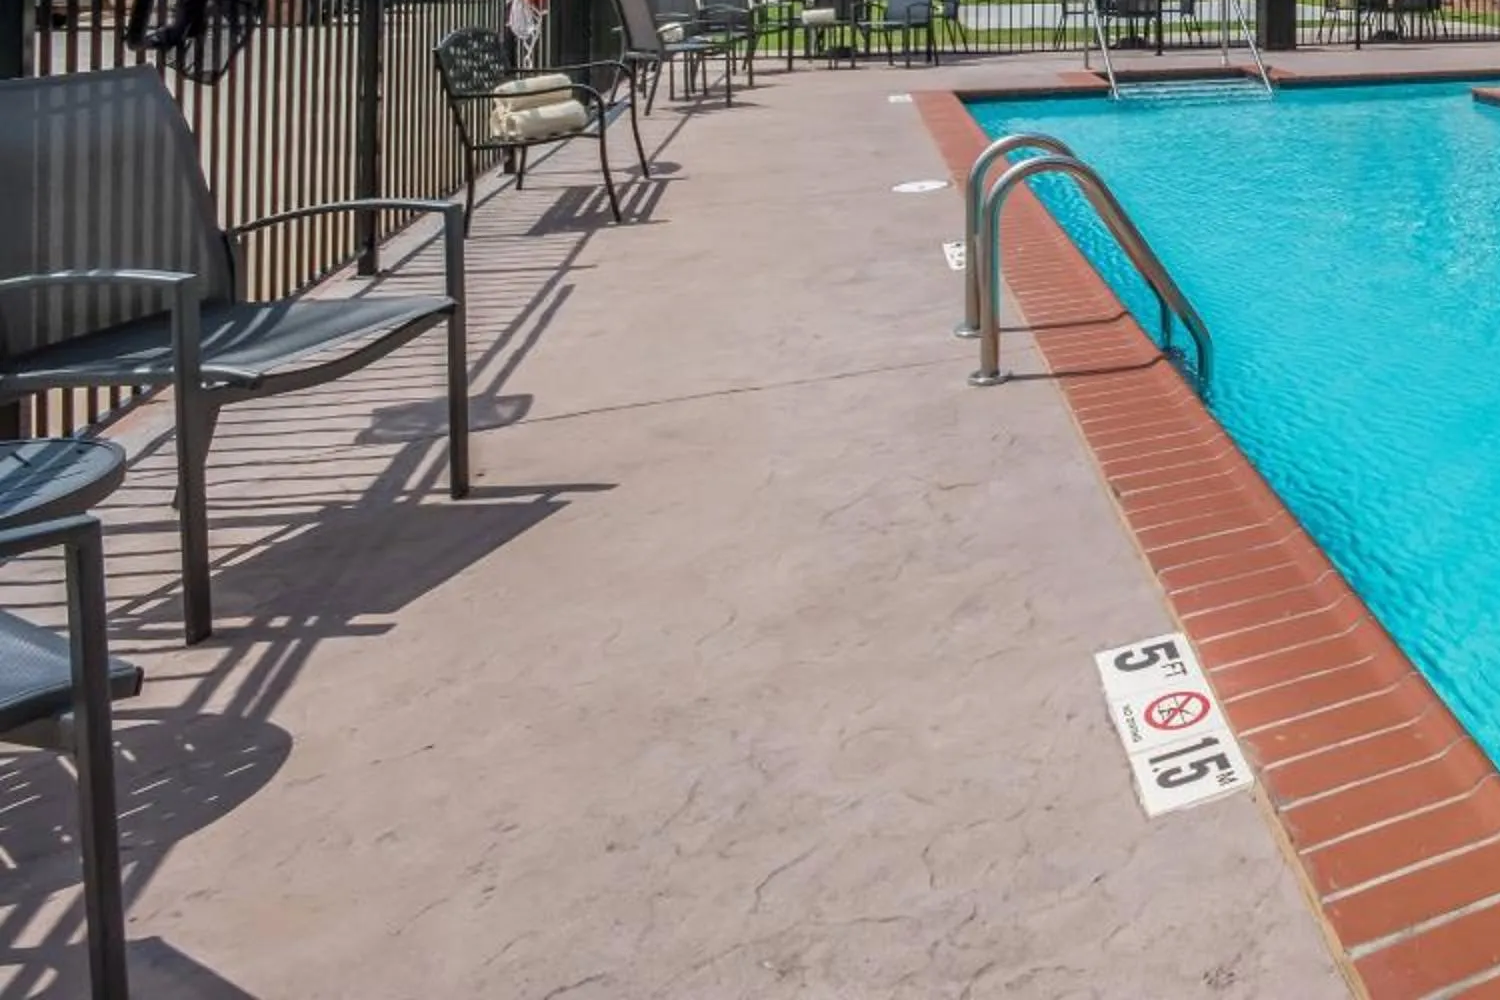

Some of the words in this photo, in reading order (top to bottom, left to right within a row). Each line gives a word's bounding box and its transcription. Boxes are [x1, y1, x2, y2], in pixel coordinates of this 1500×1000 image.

[1114, 640, 1181, 672] 5
[1161, 661, 1188, 678] FT
[1148, 736, 1233, 789] 1.5
